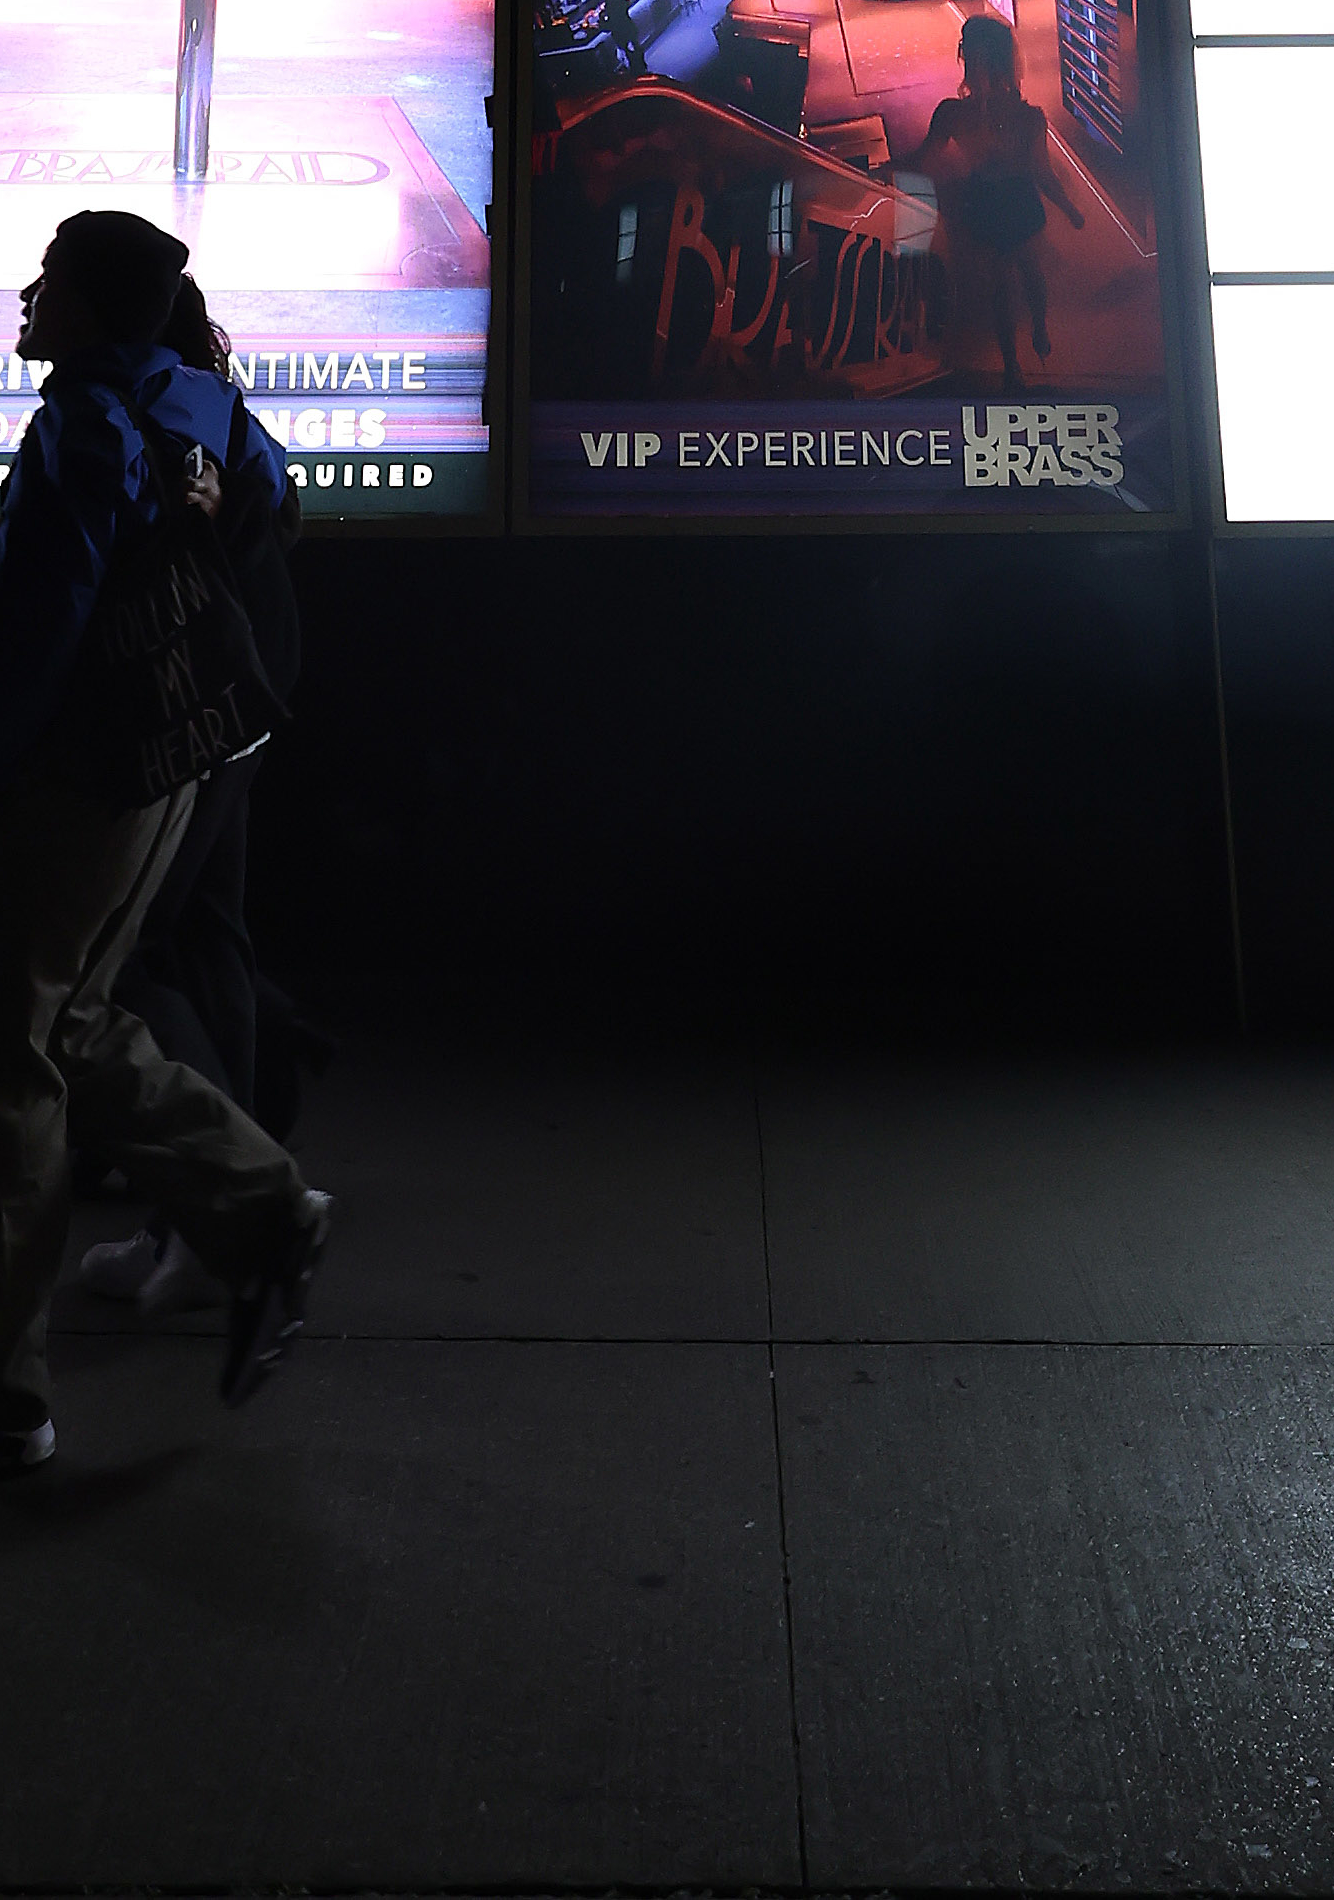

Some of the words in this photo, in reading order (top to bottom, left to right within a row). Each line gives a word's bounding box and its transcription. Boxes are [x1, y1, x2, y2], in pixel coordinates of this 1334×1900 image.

[228, 352, 426, 390] NTIMATE
[259, 408, 387, 449] NGES
[961, 404, 1123, 448] UPPER
[581, 432, 662, 467] VIP
[679, 430, 952, 466] EXPERIENCE
[962, 445, 1123, 488] BRASS
[287, 463, 433, 487] QUIRED
[153, 638, 200, 720] MY
[141, 682, 246, 796] HEART
